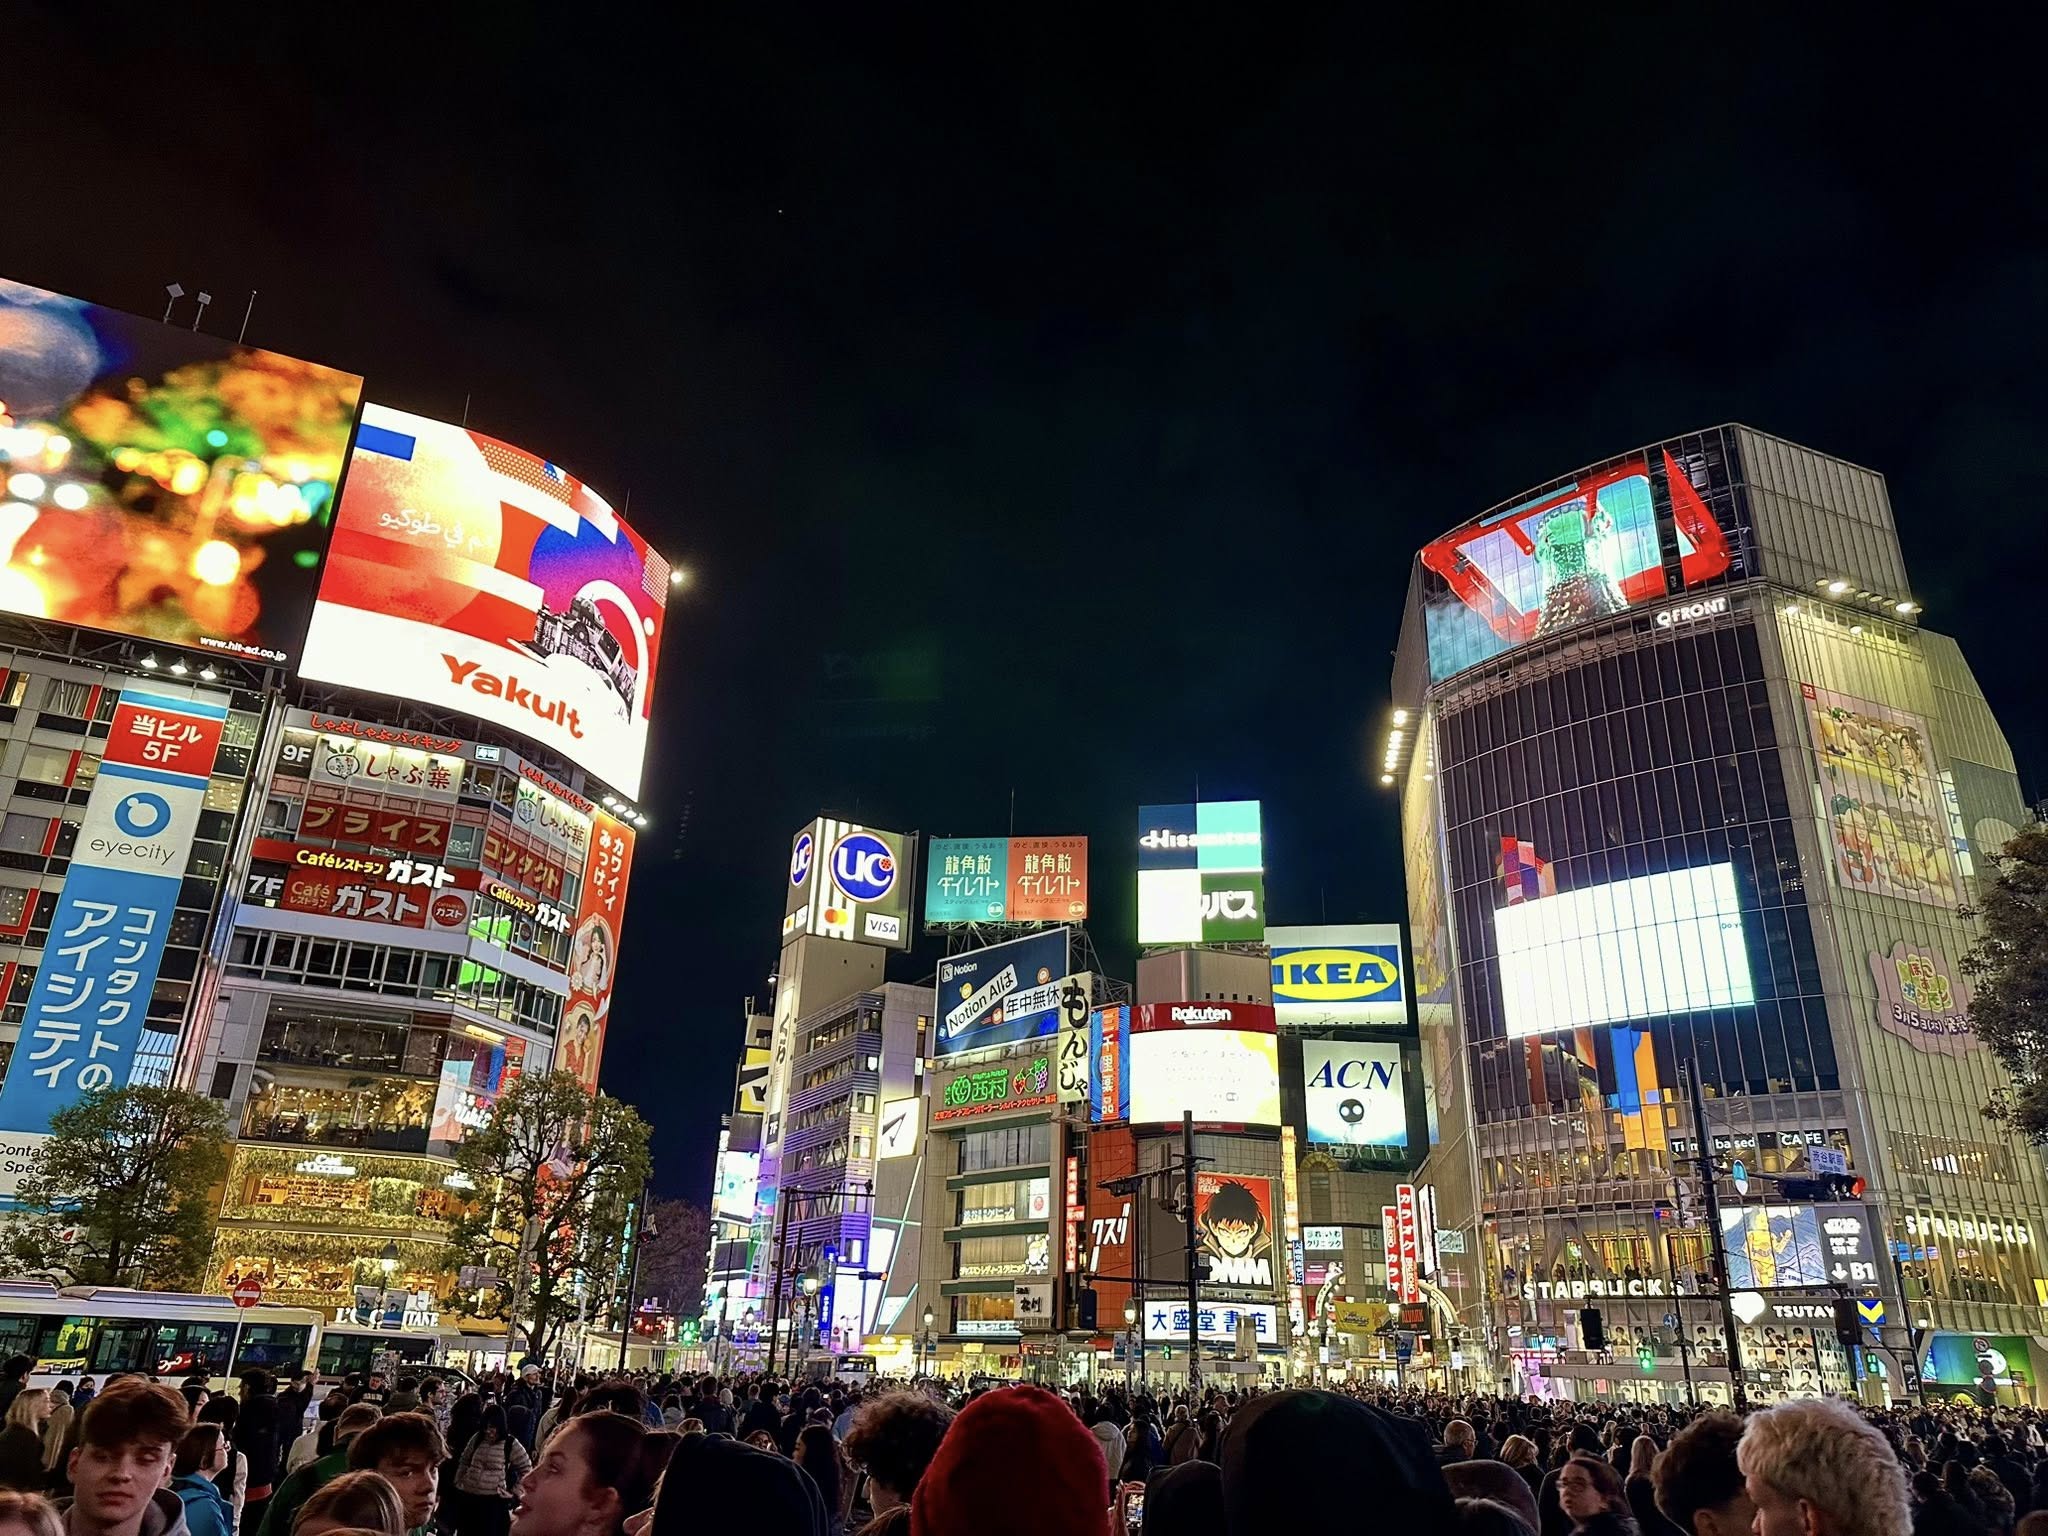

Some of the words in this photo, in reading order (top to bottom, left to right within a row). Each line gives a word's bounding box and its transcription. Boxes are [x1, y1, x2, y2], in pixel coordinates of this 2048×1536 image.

[1656, 597, 1726, 628] QFRONT
[199, 635, 288, 662] www.hit-ad.co.jp
[441, 652, 585, 740] Yakult
[129, 713, 203, 744] 当ビル
[310, 713, 463, 754] しゃぶしゃぶバイキング
[142, 741, 181, 763] 5F
[282, 744, 312, 763] 9F
[366, 754, 452, 790] しゃぶ葉
[304, 806, 443, 847] プライス
[539, 804, 585, 847] しゃぶ葉
[90, 837, 176, 865] eyecity
[483, 834, 560, 892] コンタクト
[945, 854, 992, 875] 龍角散
[1024, 853, 1072, 874] 龍角散
[248, 874, 285, 897] 7F
[385, 858, 456, 889] ガスト
[604, 837, 625, 912] カワイイ
[937, 876, 1000, 897] ダイレクト
[1017, 875, 1081, 897] ダイレクト
[291, 881, 331, 899] Café
[331, 884, 420, 922] ガスト
[534, 902, 571, 934] ガスト
[870, 919, 898, 935] VISA
[953, 962, 978, 976] Notion
[1271, 962, 1389, 985] IKEA
[28, 898, 119, 1089] アイシティ
[76, 906, 157, 1092] コンタクトの
[1005, 986, 1060, 1017] 年中無休
[949, 991, 988, 1032] Notion
[1171, 1005, 1232, 1023] Rakuten
[1059, 977, 1090, 1098] もんじゃ
[971, 1077, 1008, 1101] 西村
[1306, 1059, 1398, 1090] ACN
[1715, 1136, 1756, 1150] based
[1781, 1132, 1823, 1146] CAFE
[1400, 1193, 1414, 1251] カラオケ
[1904, 1215, 2029, 1245] STARBUCKS
[1849, 1261, 1875, 1281] B1
[1523, 1279, 1686, 1300] STARBUCKS
[1152, 1309, 1268, 1335] 大盛堂書店
[1772, 1305, 1835, 1318] TSUTAY
